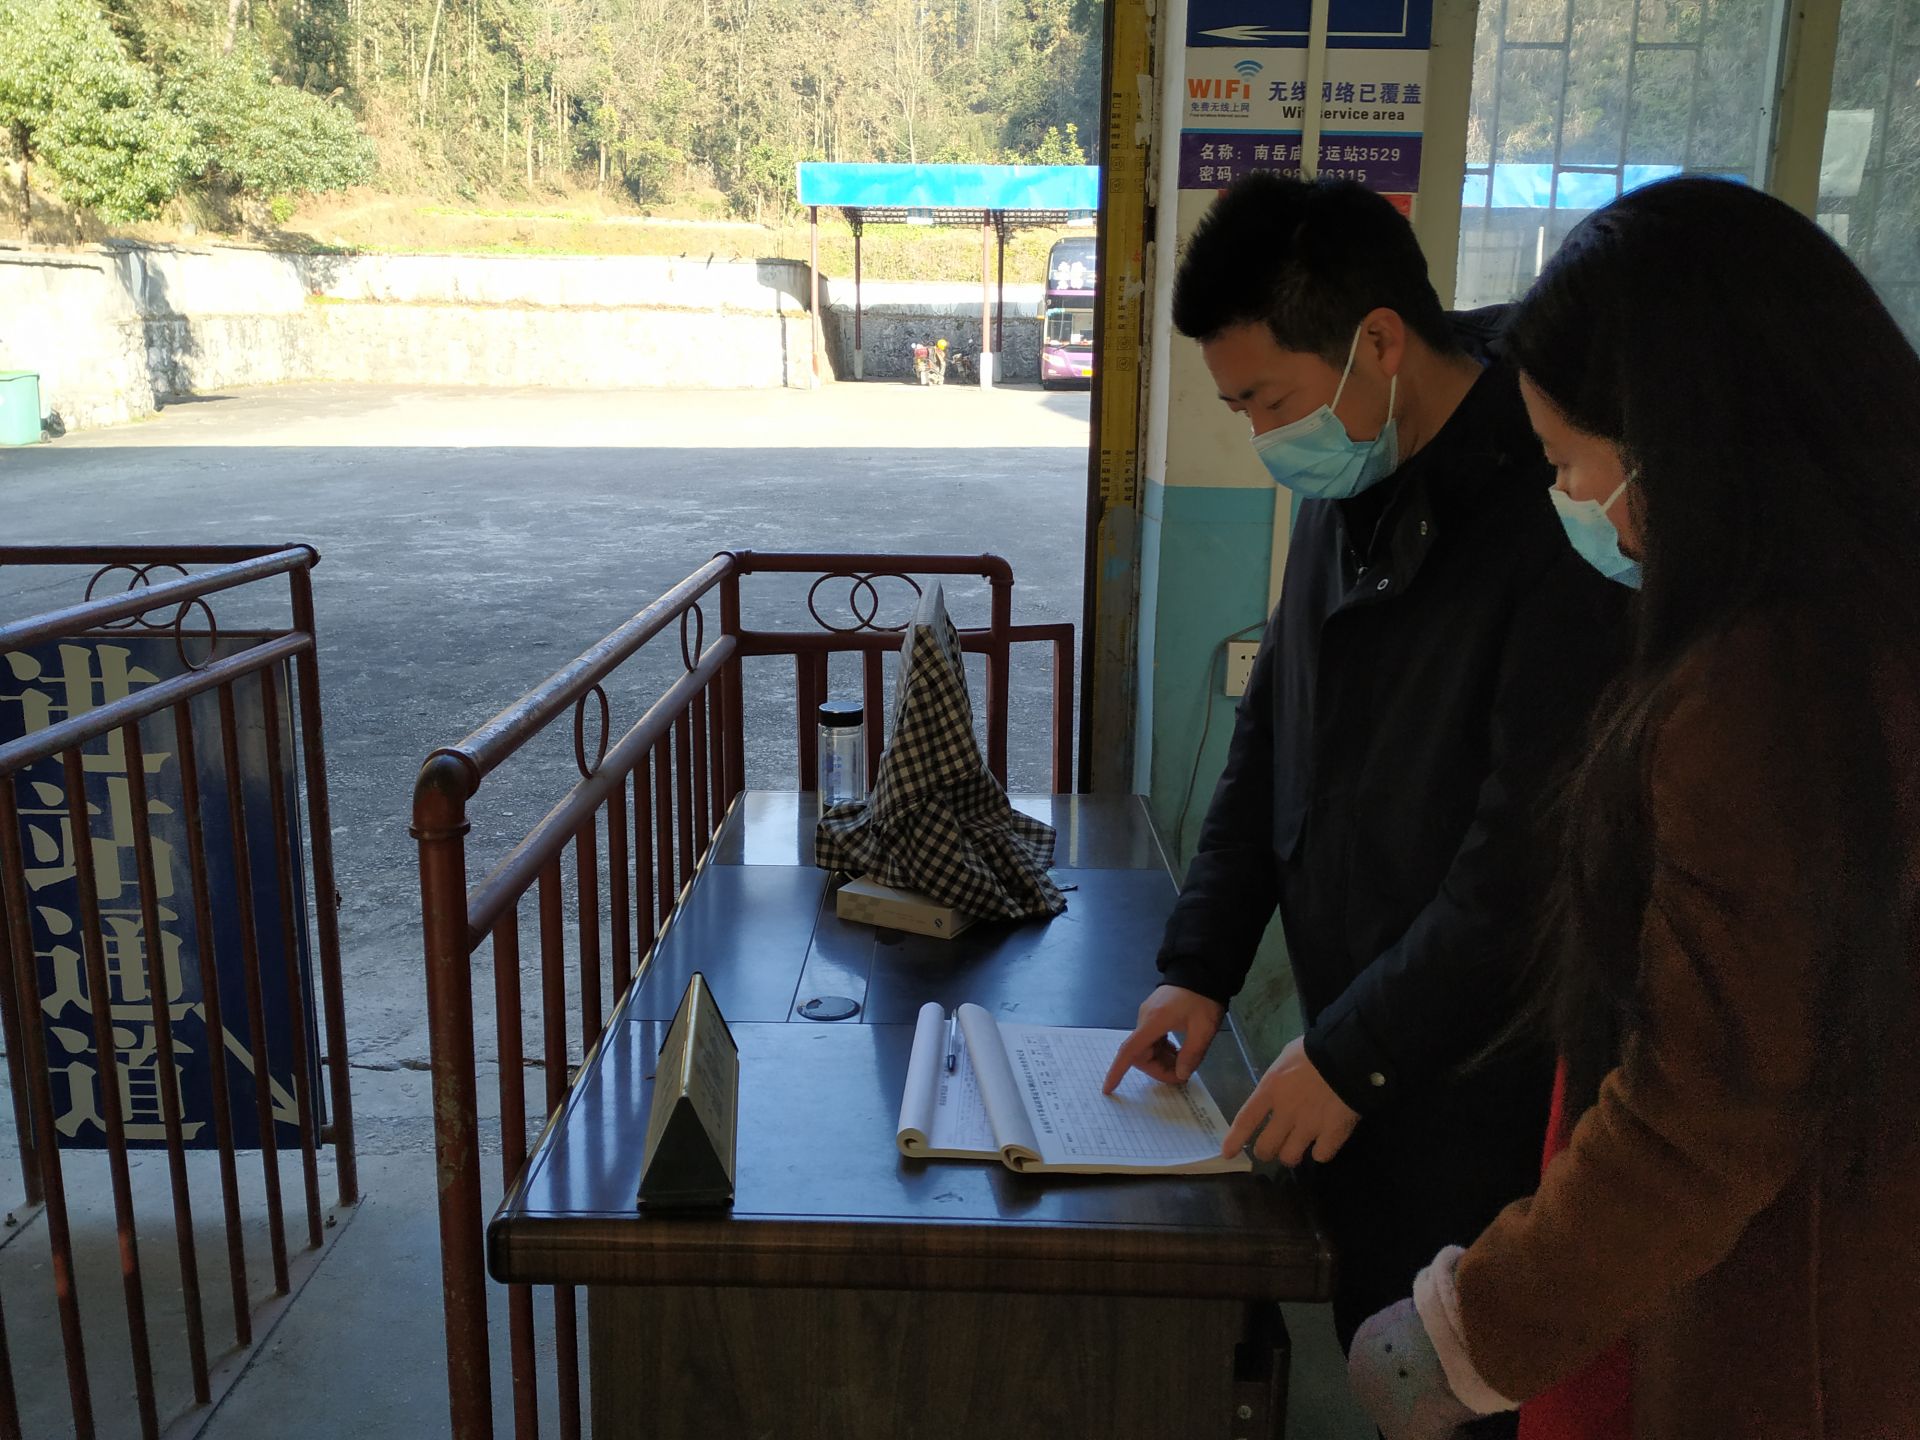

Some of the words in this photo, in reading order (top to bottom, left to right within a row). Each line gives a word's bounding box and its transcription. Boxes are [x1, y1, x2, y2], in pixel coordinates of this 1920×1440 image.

[1269, 81, 1422, 104] 无线网络已覆盖
[1191, 103, 1250, 112] 免费无线上网
[1373, 110, 1405, 121] area
[1254, 144, 1401, 162] 南岳庙运站3529
[0, 644, 205, 1140] 进站通道
